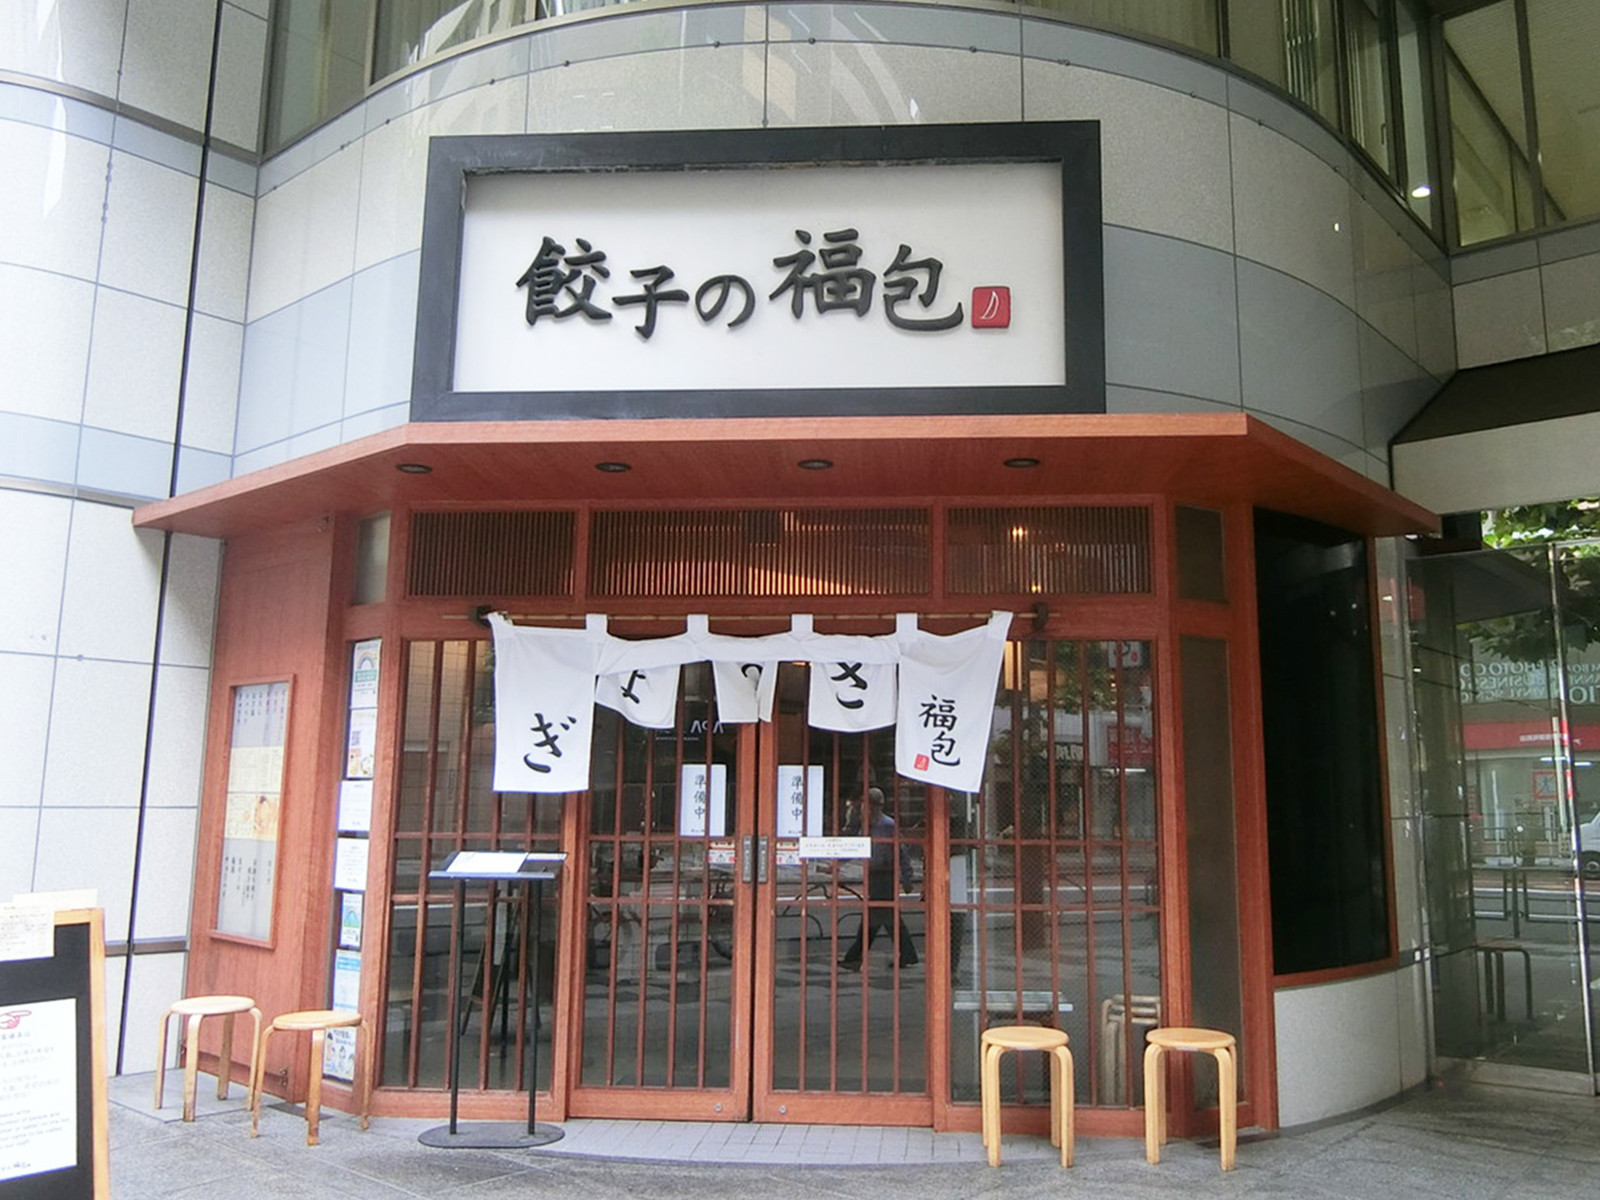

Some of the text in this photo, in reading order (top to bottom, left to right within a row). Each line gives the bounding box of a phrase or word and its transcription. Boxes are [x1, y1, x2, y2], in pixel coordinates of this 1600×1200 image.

[516, 228, 964, 340] 餃子の福包
[918, 694, 961, 767] 福包
